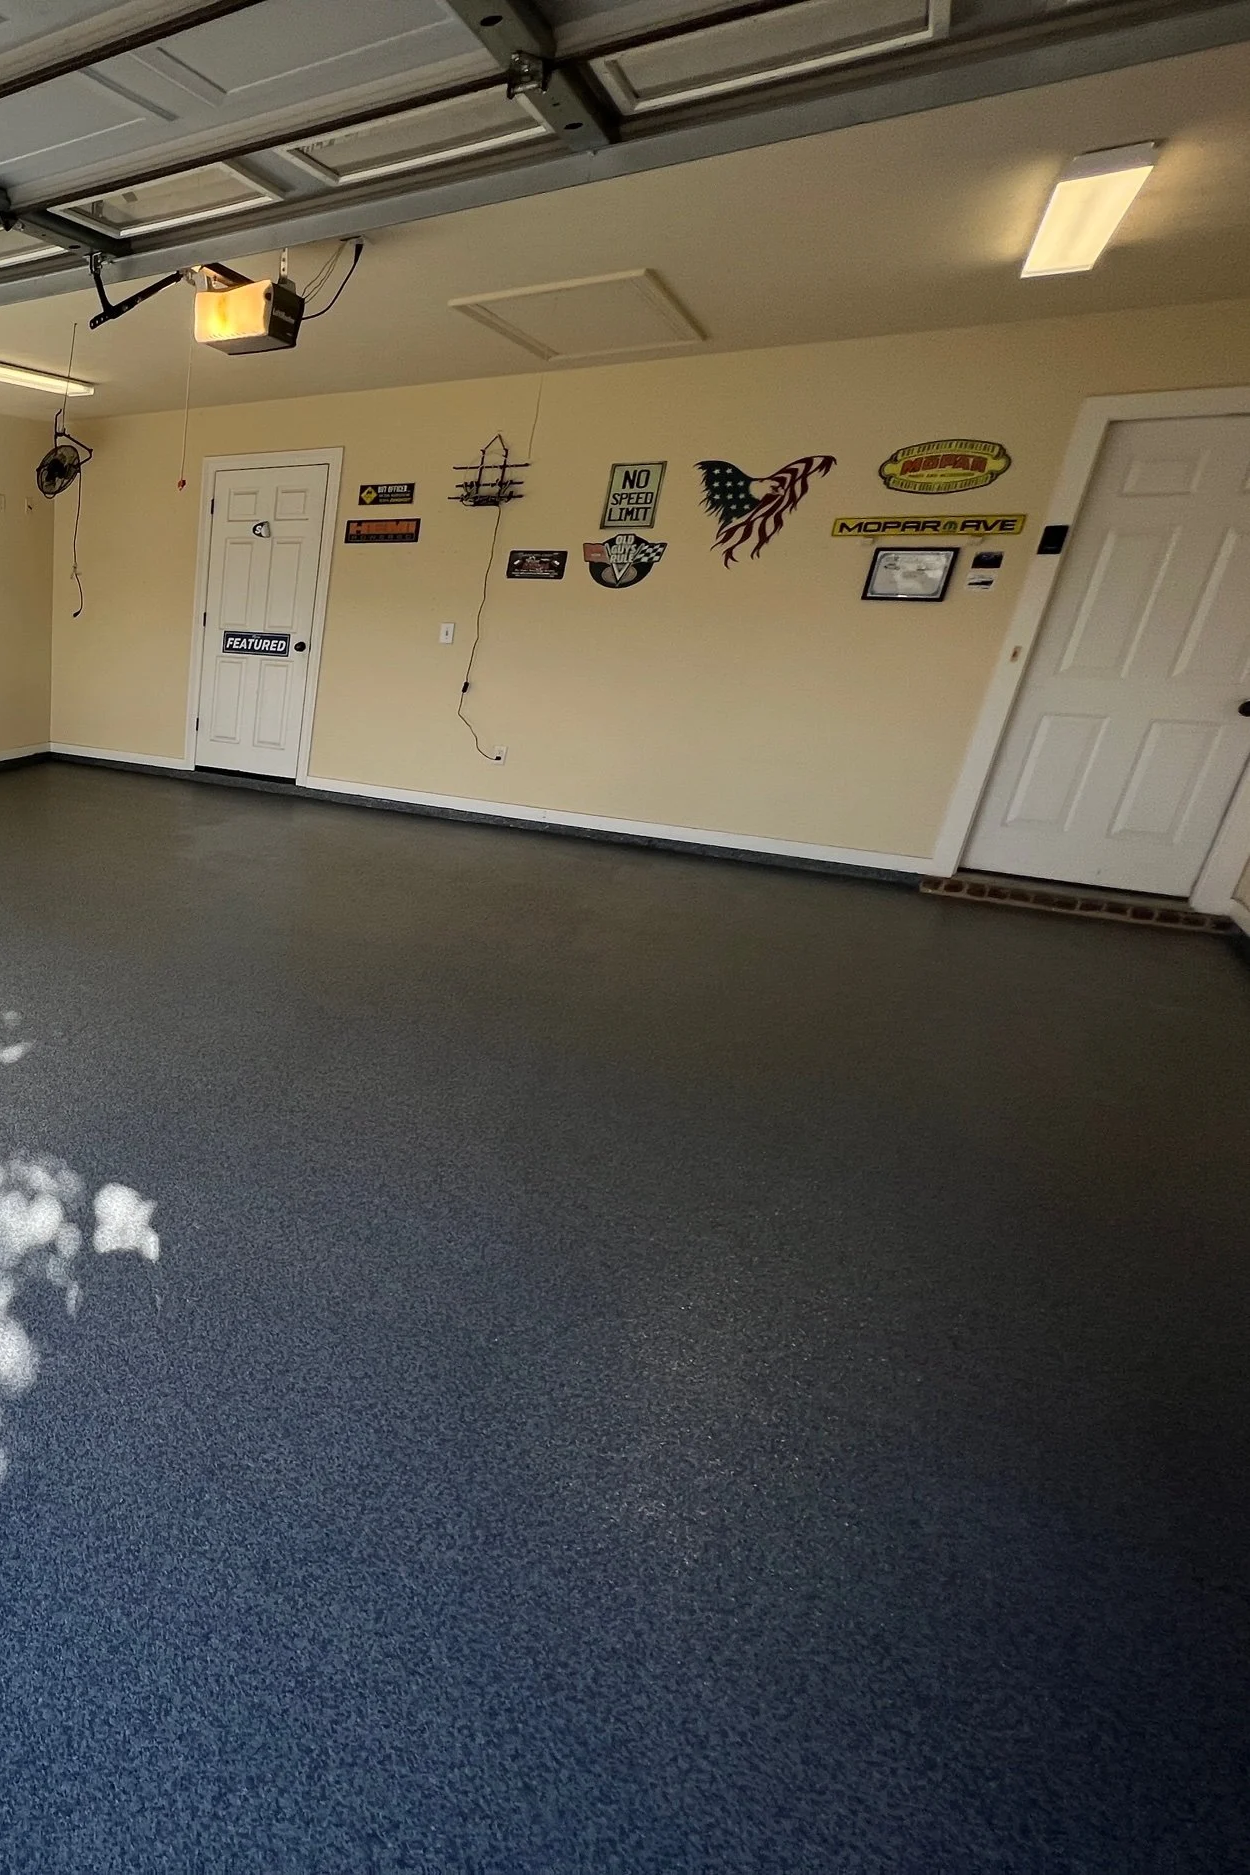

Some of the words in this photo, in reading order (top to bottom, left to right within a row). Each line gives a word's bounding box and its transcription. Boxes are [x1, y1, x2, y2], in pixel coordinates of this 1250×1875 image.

[900, 453, 988, 476] MOPAR
[621, 469, 651, 490] NO
[610, 491, 654, 506] SPEED
[607, 506, 652, 522] LIMIT
[838, 520, 940, 534] MOPAR
[959, 519, 1018, 532] AVE
[615, 535, 635, 545] OLD
[610, 543, 637, 554] GUYS
[610, 553, 634, 564] RULE
[226, 637, 287, 652] FEATURED
